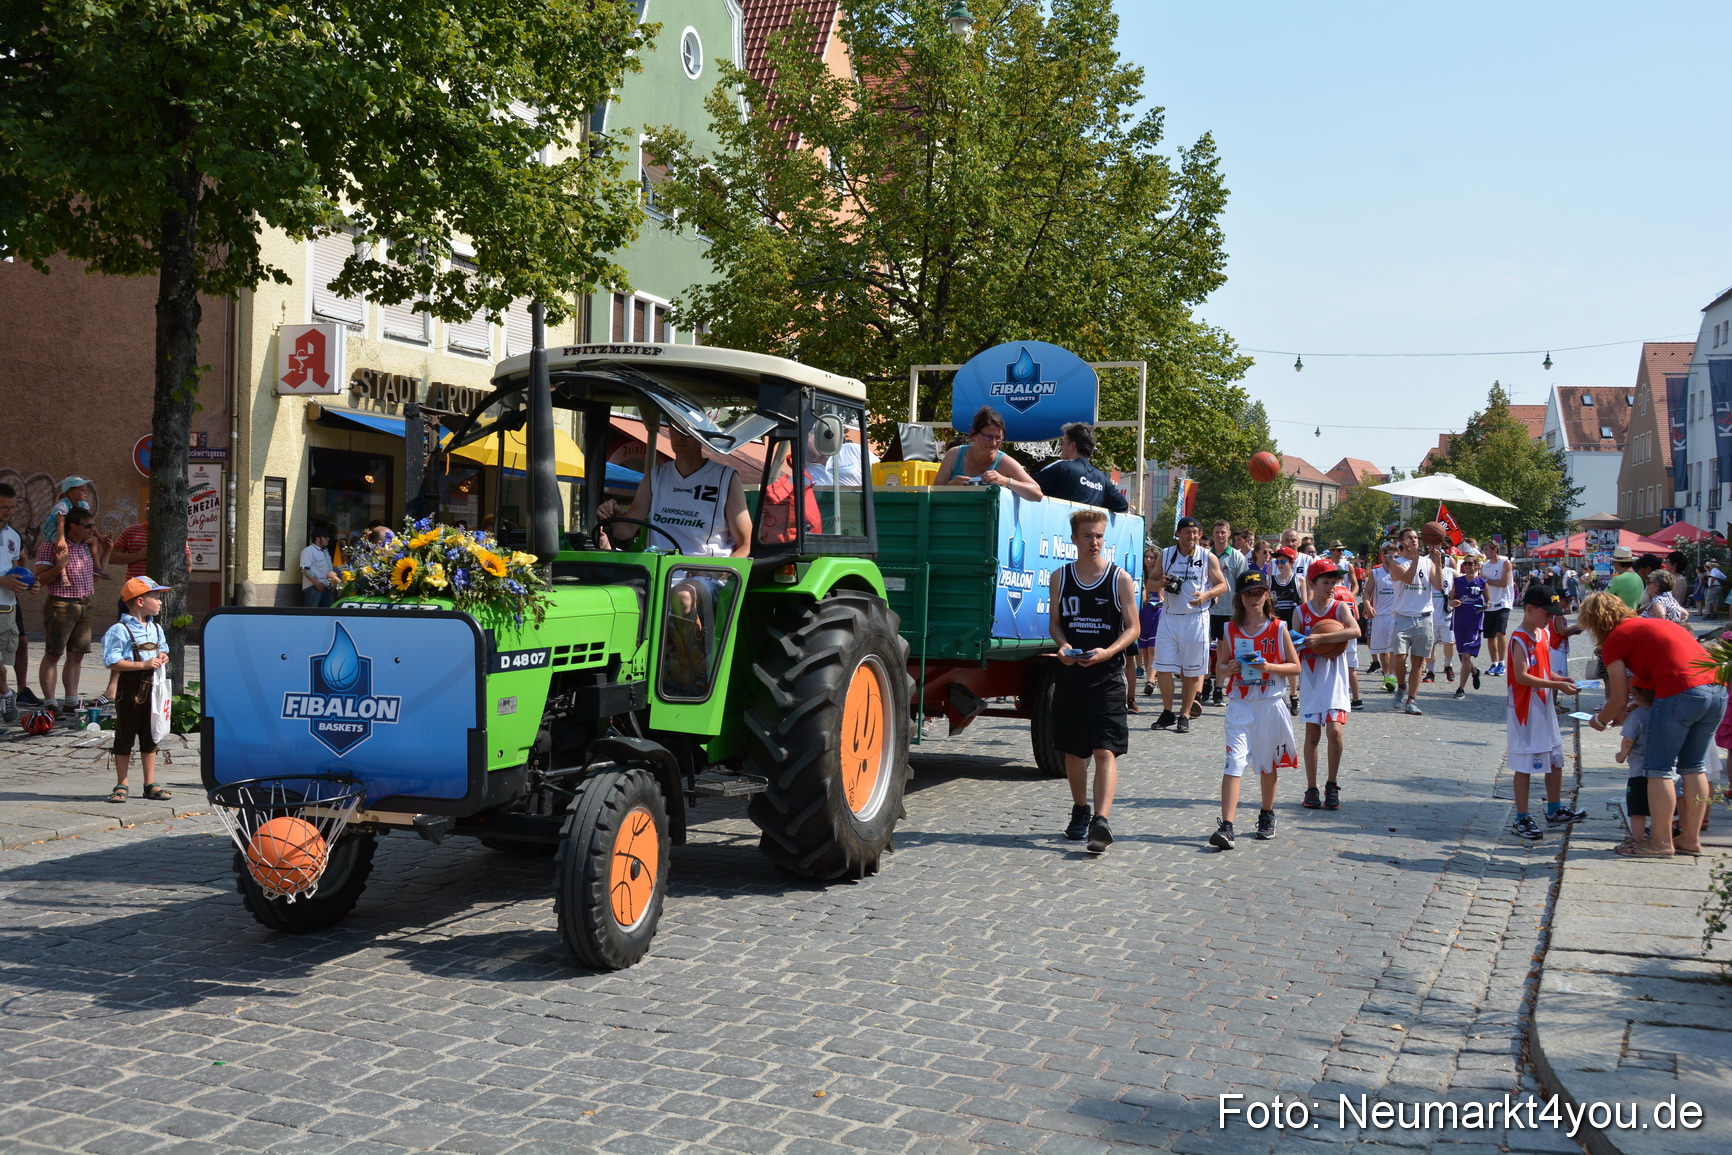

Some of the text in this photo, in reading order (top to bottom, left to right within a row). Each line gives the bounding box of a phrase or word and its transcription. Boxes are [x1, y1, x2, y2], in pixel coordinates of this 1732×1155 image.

[357, 368, 422, 404] STADT
[991, 382, 1055, 395] FIBALON
[188, 449, 226, 459] ockwirtsgasse
[1079, 476, 1104, 492] Coach
[693, 484, 719, 503] 12
[187, 496, 220, 515] ENEZIA
[661, 507, 701, 518] FAHRSCHULE
[652, 513, 706, 529] Dominik
[1039, 532, 1049, 558] In
[1062, 595, 1081, 617] 10
[1261, 638, 1276, 654] 11
[500, 655, 511, 669] D
[284, 695, 400, 720] FIBALON
[318, 722, 364, 733] BASKETS
